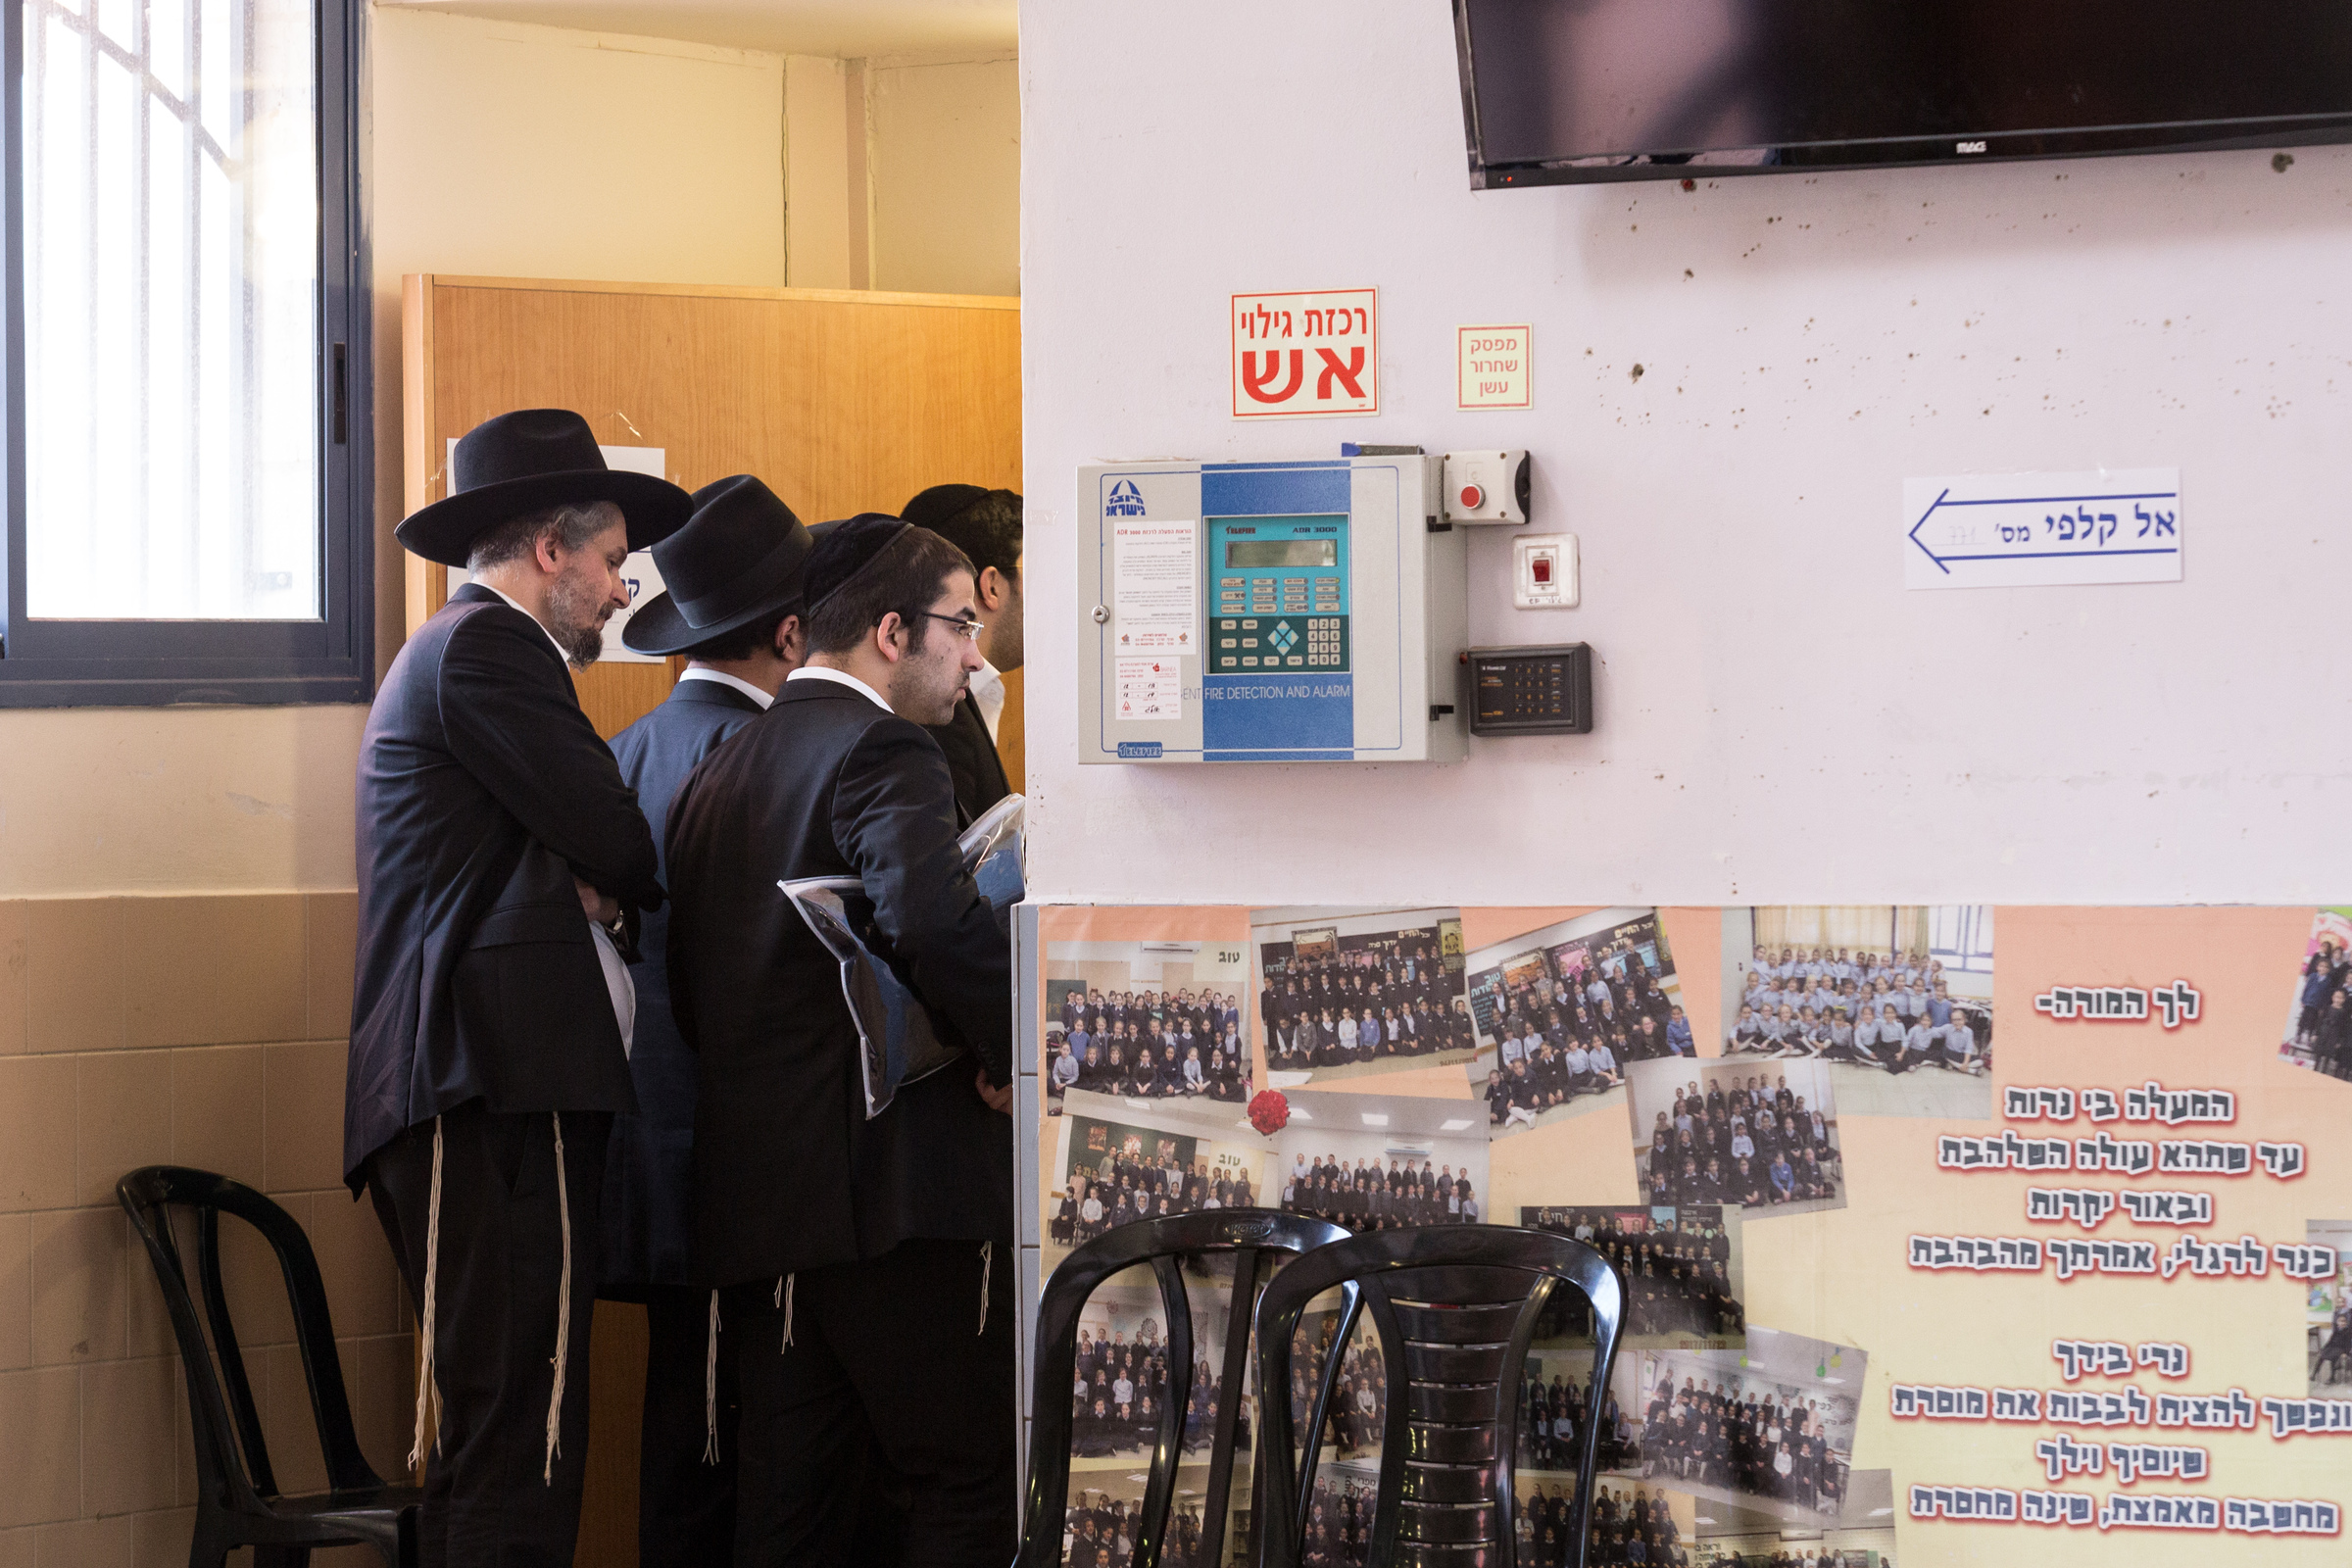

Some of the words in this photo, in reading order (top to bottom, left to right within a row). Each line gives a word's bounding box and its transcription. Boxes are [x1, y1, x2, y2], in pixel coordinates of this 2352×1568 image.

[1241, 303, 1293, 339] גילוי
[1304, 308, 1367, 337] רכזת
[1470, 338, 1517, 355] מפסק
[1242, 346, 1367, 404] אש
[1470, 359, 1518, 372] שחרור
[1479, 381, 1508, 397] עשן
[1993, 523, 2031, 544] מס'
[2045, 505, 2117, 547] קלפי
[2134, 503, 2176, 538] אל
[1204, 687, 1224, 700] FIRE
[1227, 686, 1284, 700] DETECTION
[1286, 685, 1310, 698] AND
[1313, 685, 1350, 698] ALARM
[1218, 952, 1240, 963] טוב
[2037, 989, 2145, 1016] המורה-
[2155, 983, 2196, 1025] לך
[2007, 1089, 2072, 1118] נרות
[2083, 1091, 2117, 1119] בי
[2128, 1084, 2230, 1122] המעלה
[1218, 1153, 1241, 1166] טוב
[1940, 1132, 2068, 1168] השלהבת
[2079, 1134, 2150, 1172] עולה
[2161, 1143, 2248, 1172] שתהא
[2259, 1144, 2300, 1175] עד
[2030, 1190, 2112, 1225] יקרות
[2123, 1192, 2209, 1222] ובאור
[1911, 1238, 2038, 1267] מהבהבת
[2049, 1241, 2153, 1276] אמרתך
[2163, 1237, 2264, 1275] לרגלי,
[2276, 1247, 2332, 1276] כנר
[2055, 1342, 2130, 1377] בידך
[2140, 1345, 2184, 1374] נרי
[1893, 1387, 1984, 1416] מוסרת
[1995, 1390, 2038, 1418] את
[2049, 1388, 2147, 1423] לבבות
[2159, 1391, 2252, 1425] להצית
[2265, 1399, 2352, 1435] ונפשך
[2039, 1436, 2100, 1477] וילך
[2111, 1446, 2203, 1480] שיוסיף
[1912, 1487, 2014, 1518] מחסרת
[2025, 1493, 2090, 1522] שינה
[2100, 1495, 2216, 1528] מאמצת,
[2228, 1500, 2335, 1531] מחשבה
